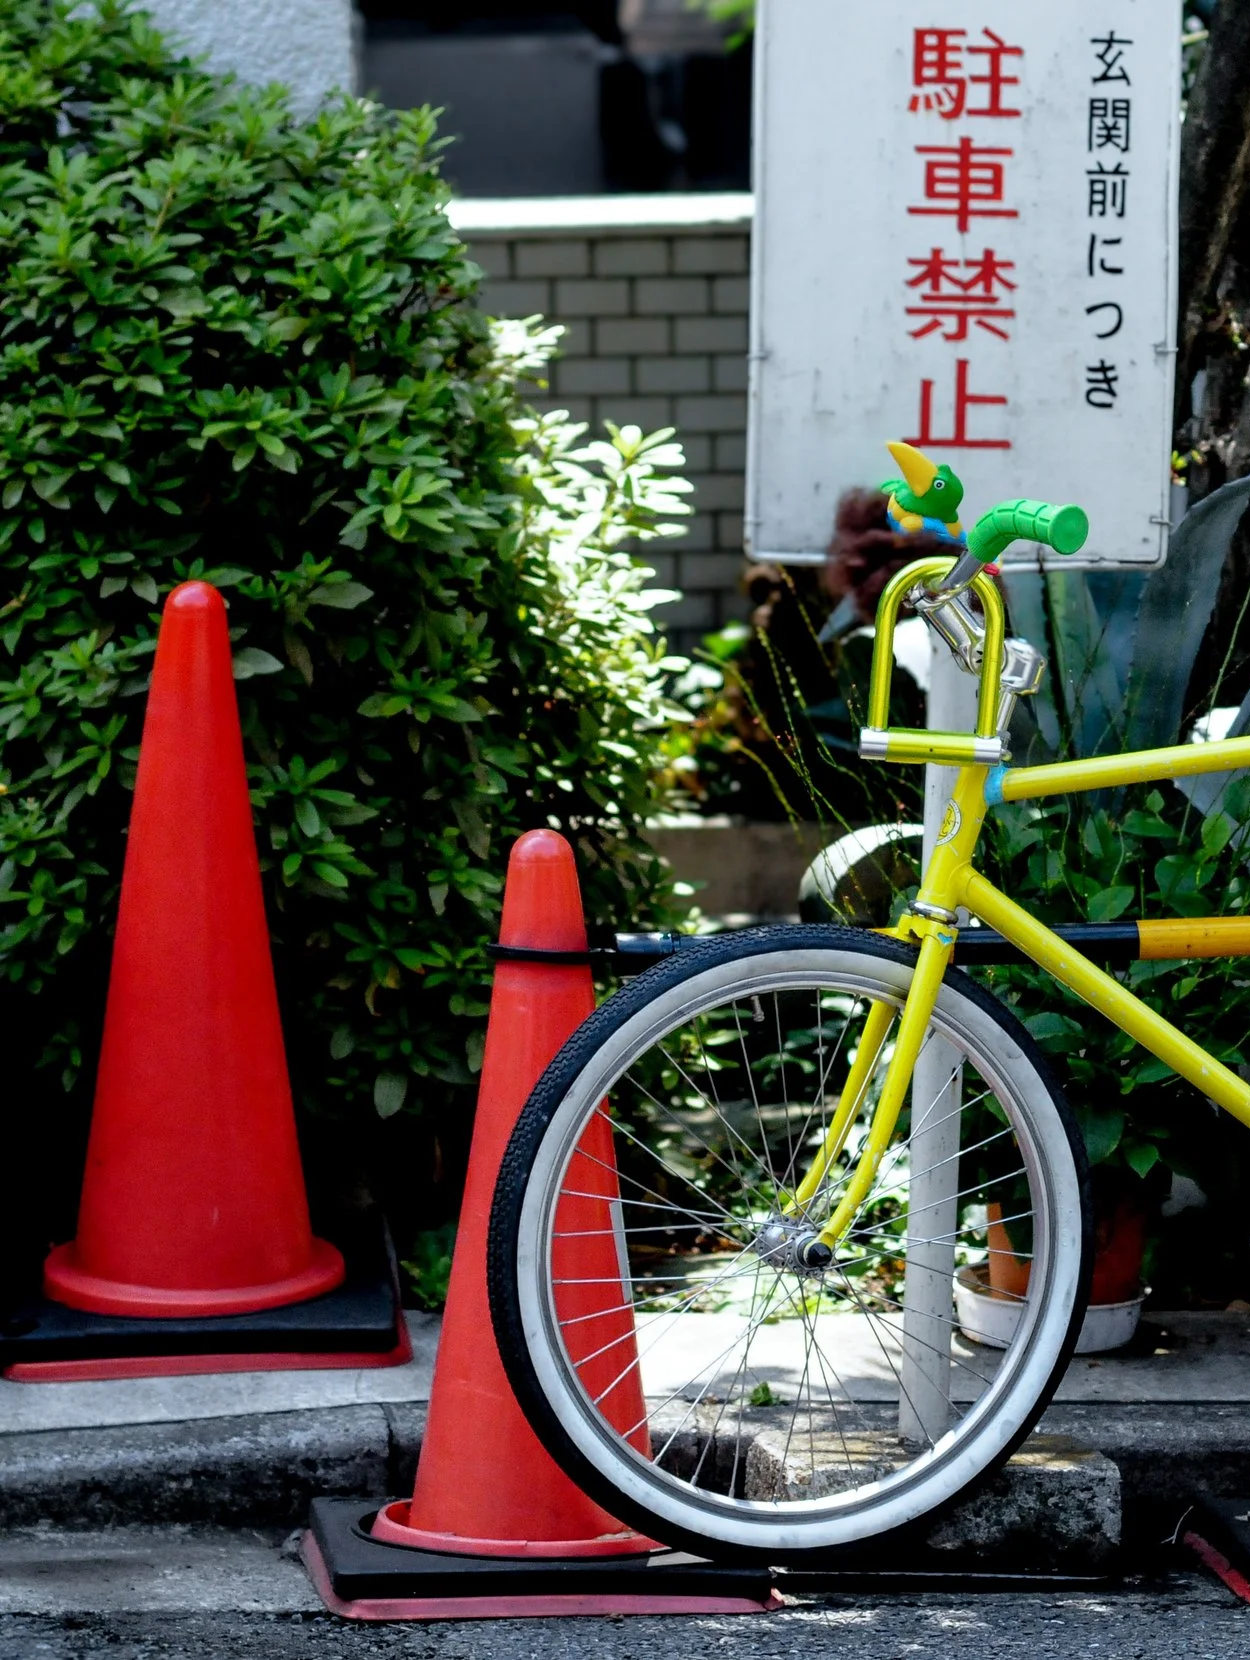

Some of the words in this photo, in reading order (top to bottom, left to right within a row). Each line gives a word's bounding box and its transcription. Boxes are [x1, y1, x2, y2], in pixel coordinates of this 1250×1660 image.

[904, 27, 1024, 450] 駐車禁止
[1085, 30, 1134, 409] 玄関前につき
